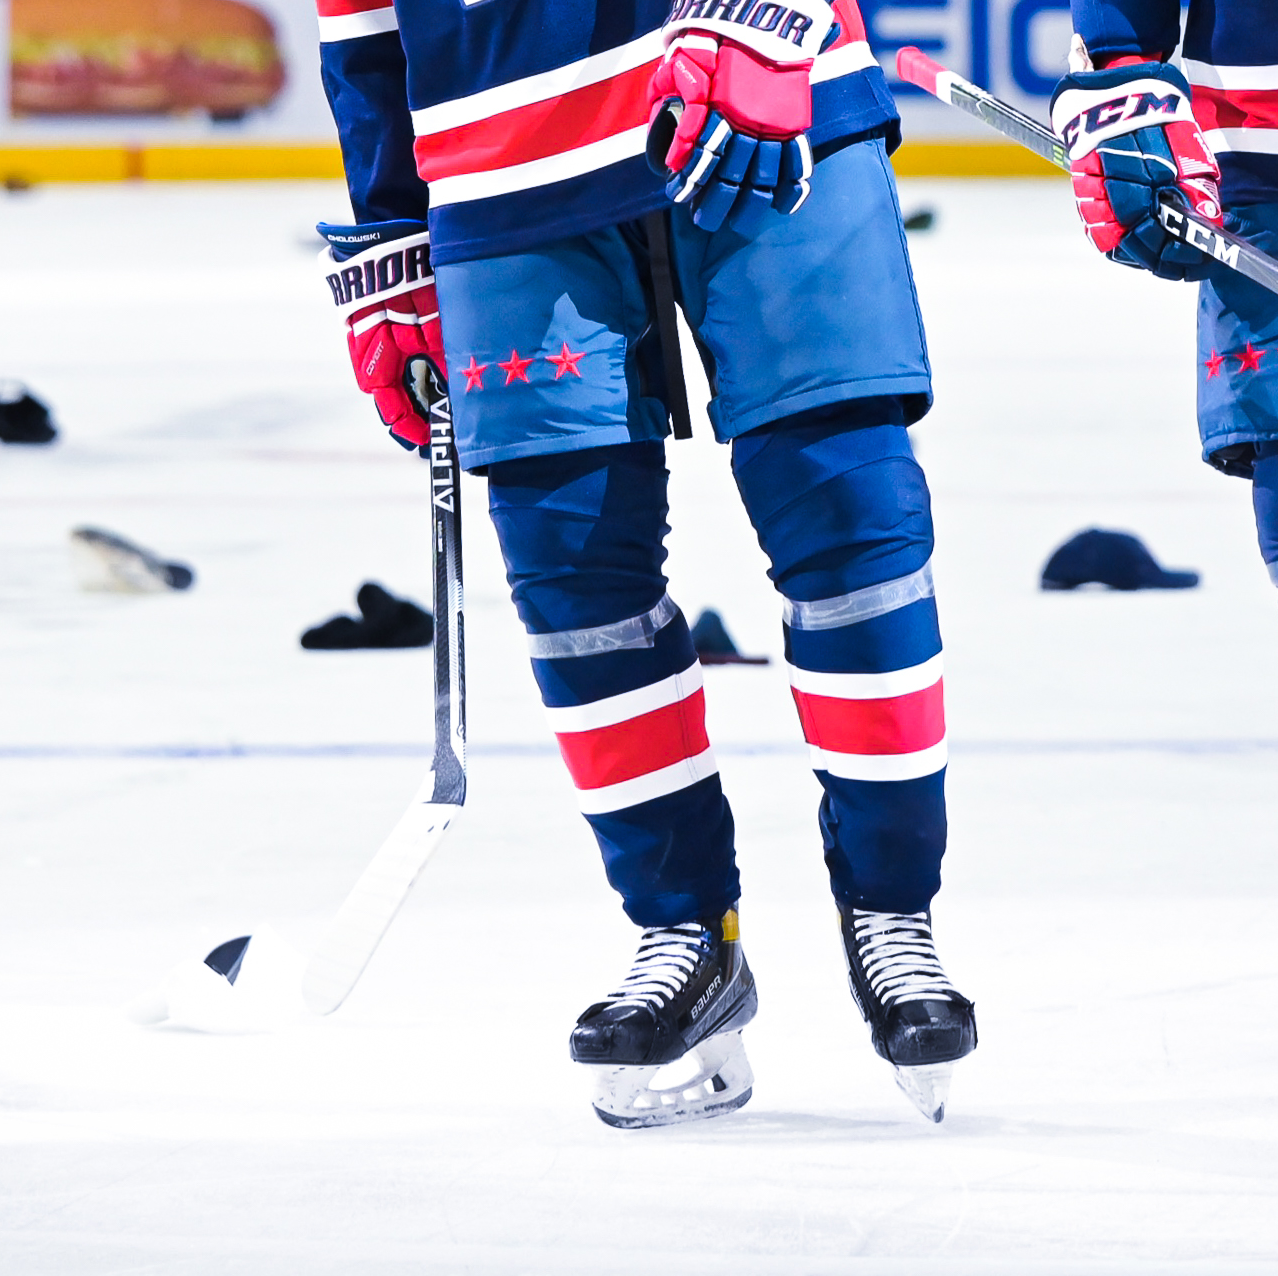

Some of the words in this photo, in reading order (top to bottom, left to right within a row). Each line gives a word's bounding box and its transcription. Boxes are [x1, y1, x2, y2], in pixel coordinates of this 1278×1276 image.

[1061, 92, 1182, 148] CCM
[1159, 200, 1241, 269] CCM
[325, 242, 435, 307] RRIOR
[430, 396, 456, 514] ALPHA
[690, 974, 723, 1020] BAUER
